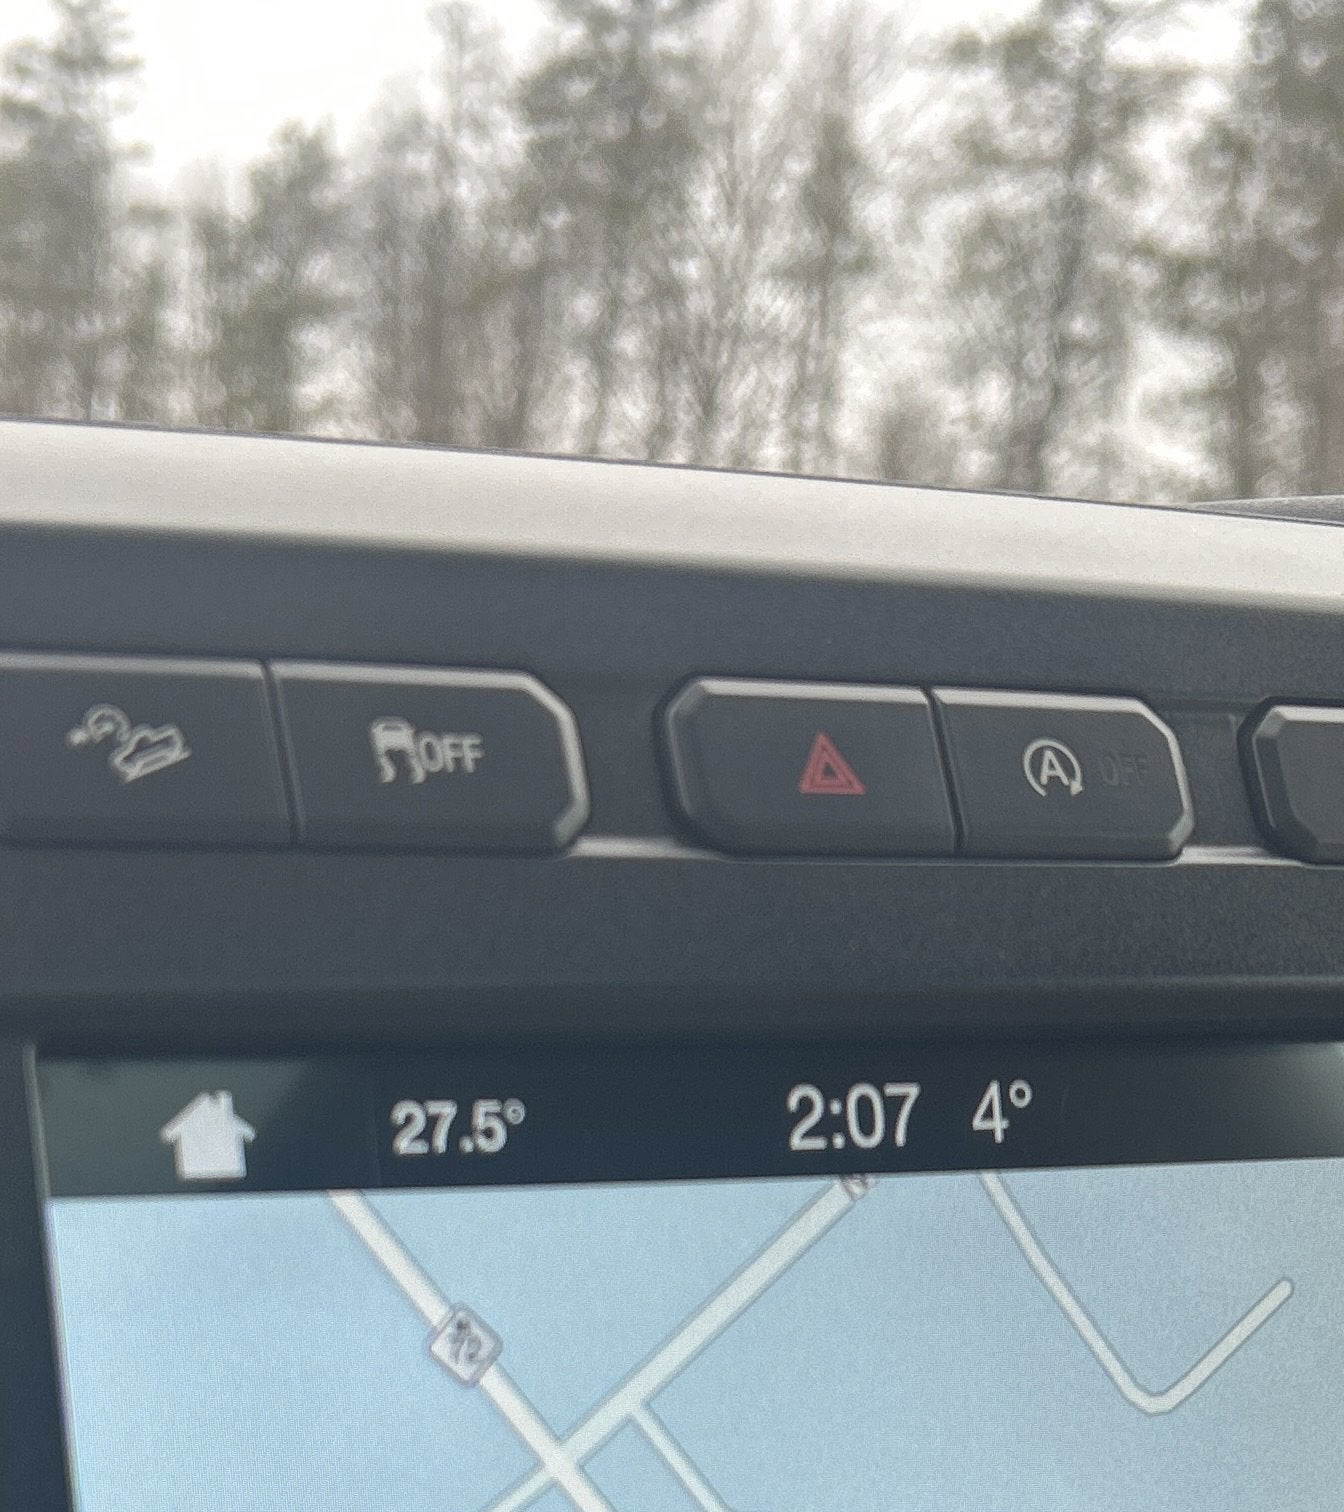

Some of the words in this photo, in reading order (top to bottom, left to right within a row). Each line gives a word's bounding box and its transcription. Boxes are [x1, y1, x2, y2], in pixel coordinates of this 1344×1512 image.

[419, 730, 485, 773] OFF
[390, 1098, 526, 1154] 27.5°
[786, 1082, 921, 1150] 2:07
[972, 1079, 1033, 1144] 4°
